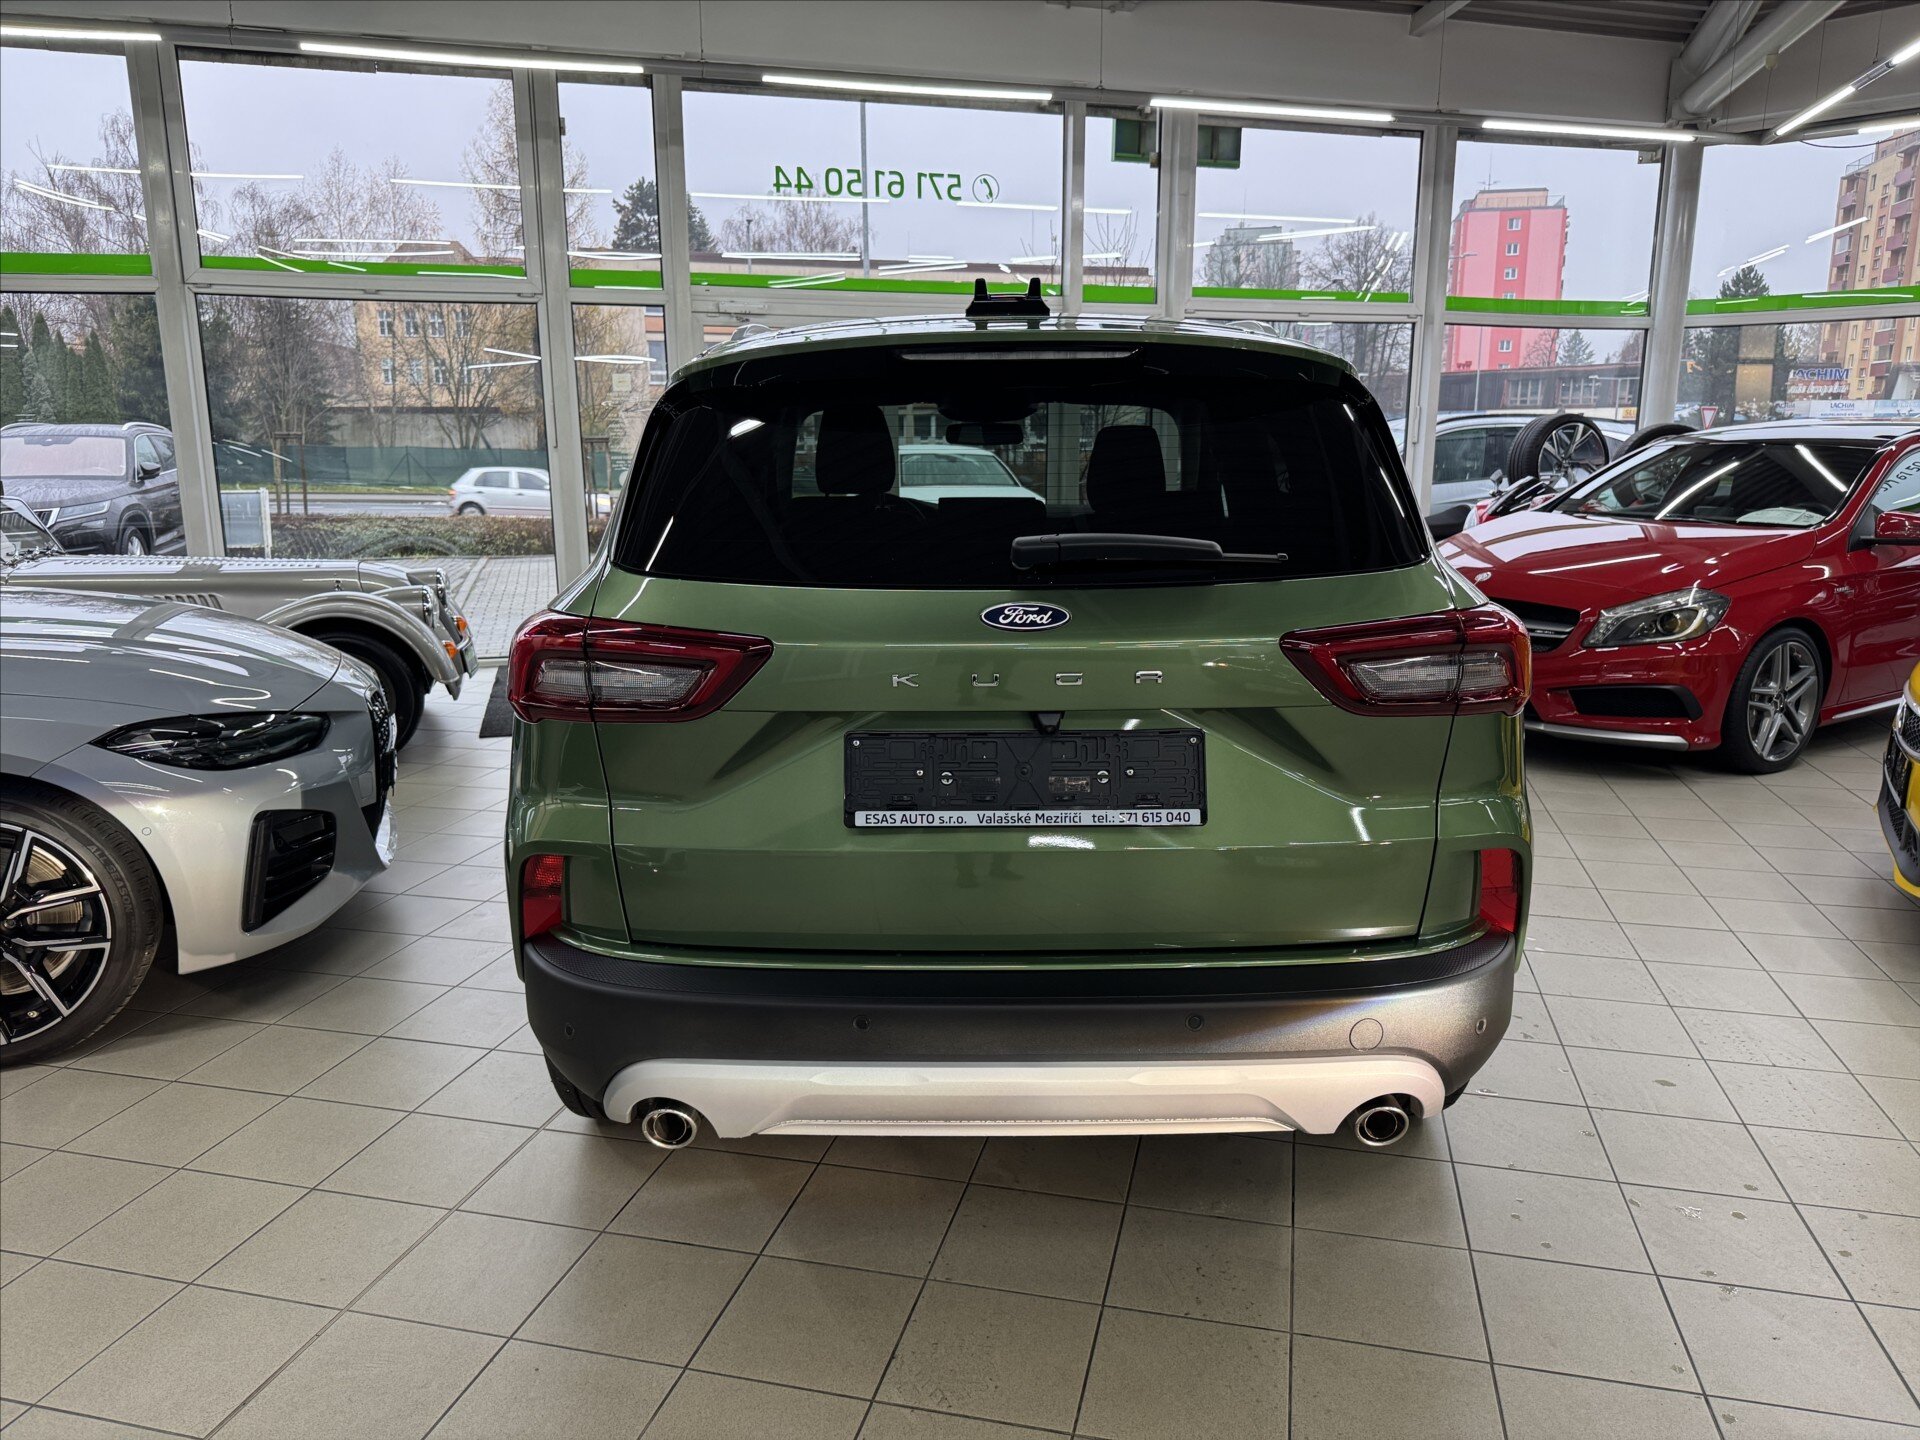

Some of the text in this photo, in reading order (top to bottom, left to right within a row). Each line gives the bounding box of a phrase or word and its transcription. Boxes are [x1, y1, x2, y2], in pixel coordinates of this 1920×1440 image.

[998, 606, 1054, 625] Ford
[892, 670, 1164, 687] KUGA
[865, 813, 897, 825] ESAS
[900, 813, 935, 825] AUTO
[938, 814, 967, 825] s.r.o.
[977, 812, 1032, 824] Valašské
[1035, 812, 1082, 824] Meziříčí
[1118, 812, 1138, 823] 571
[1142, 812, 1163, 823] 615
[1166, 811, 1191, 823] 040
